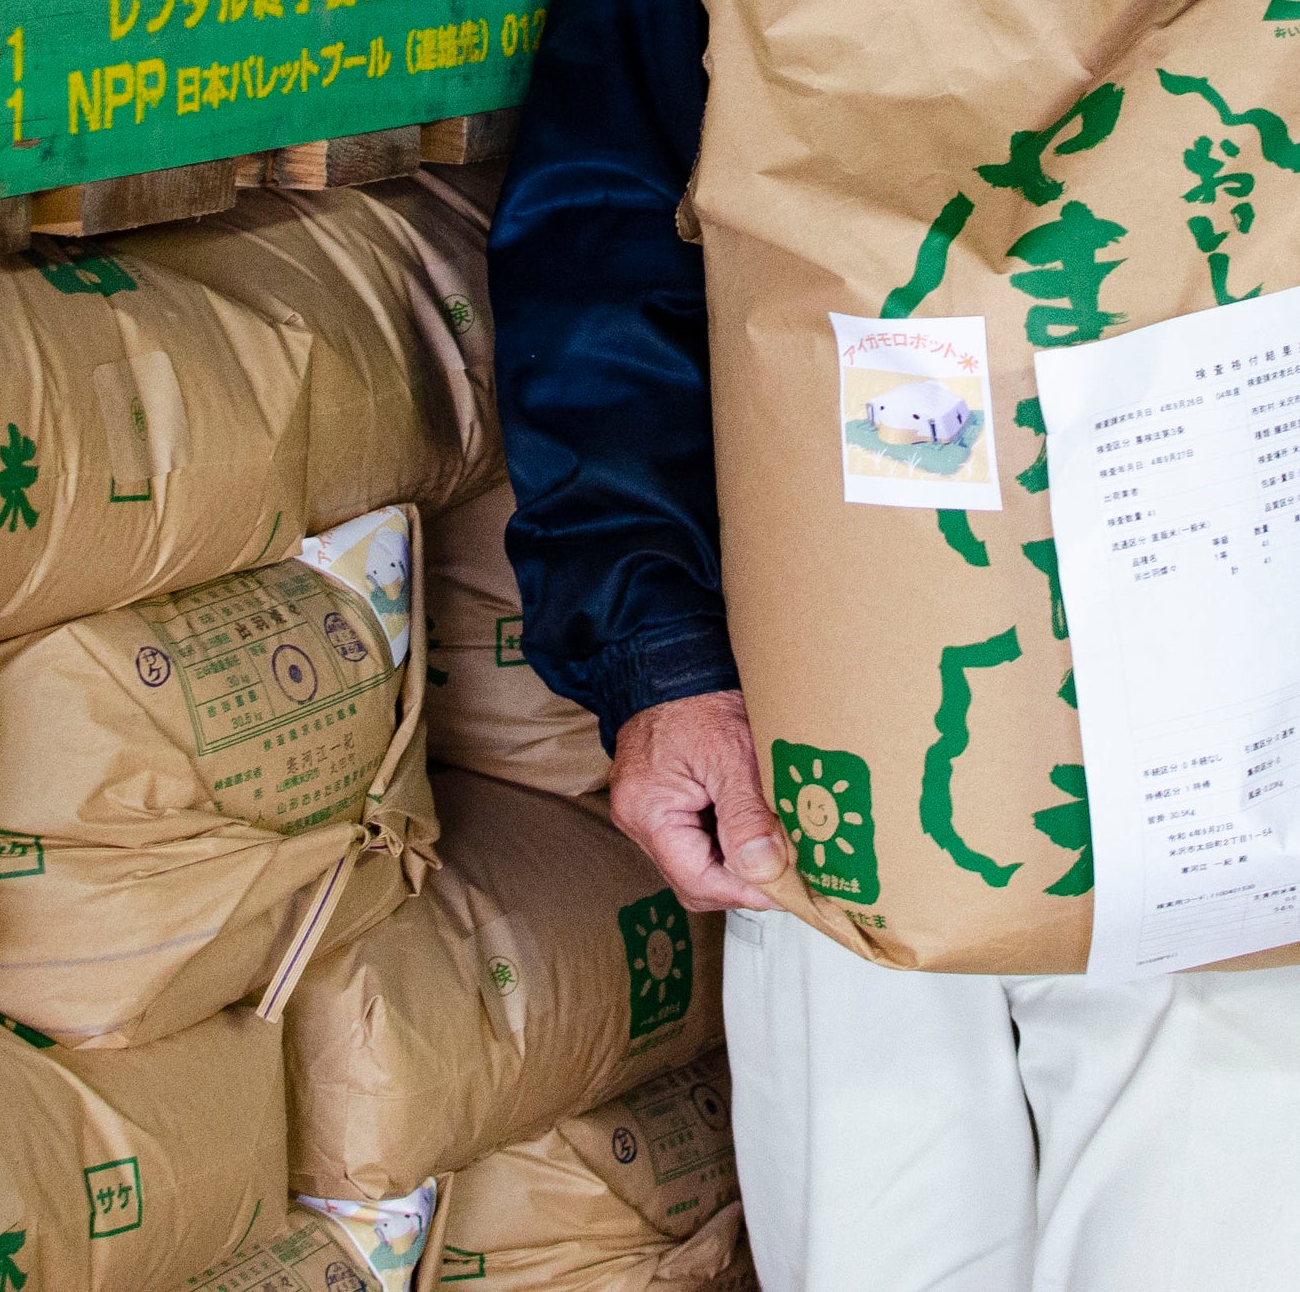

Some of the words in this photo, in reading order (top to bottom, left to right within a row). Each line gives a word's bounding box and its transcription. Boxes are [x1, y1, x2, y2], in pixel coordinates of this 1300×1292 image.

[68, 57, 167, 136] NPP
[176, 36, 393, 116] 日本パレットプール
[841, 330, 981, 376] アイガモロボット米
[96, 1183, 133, 1215] サケ
